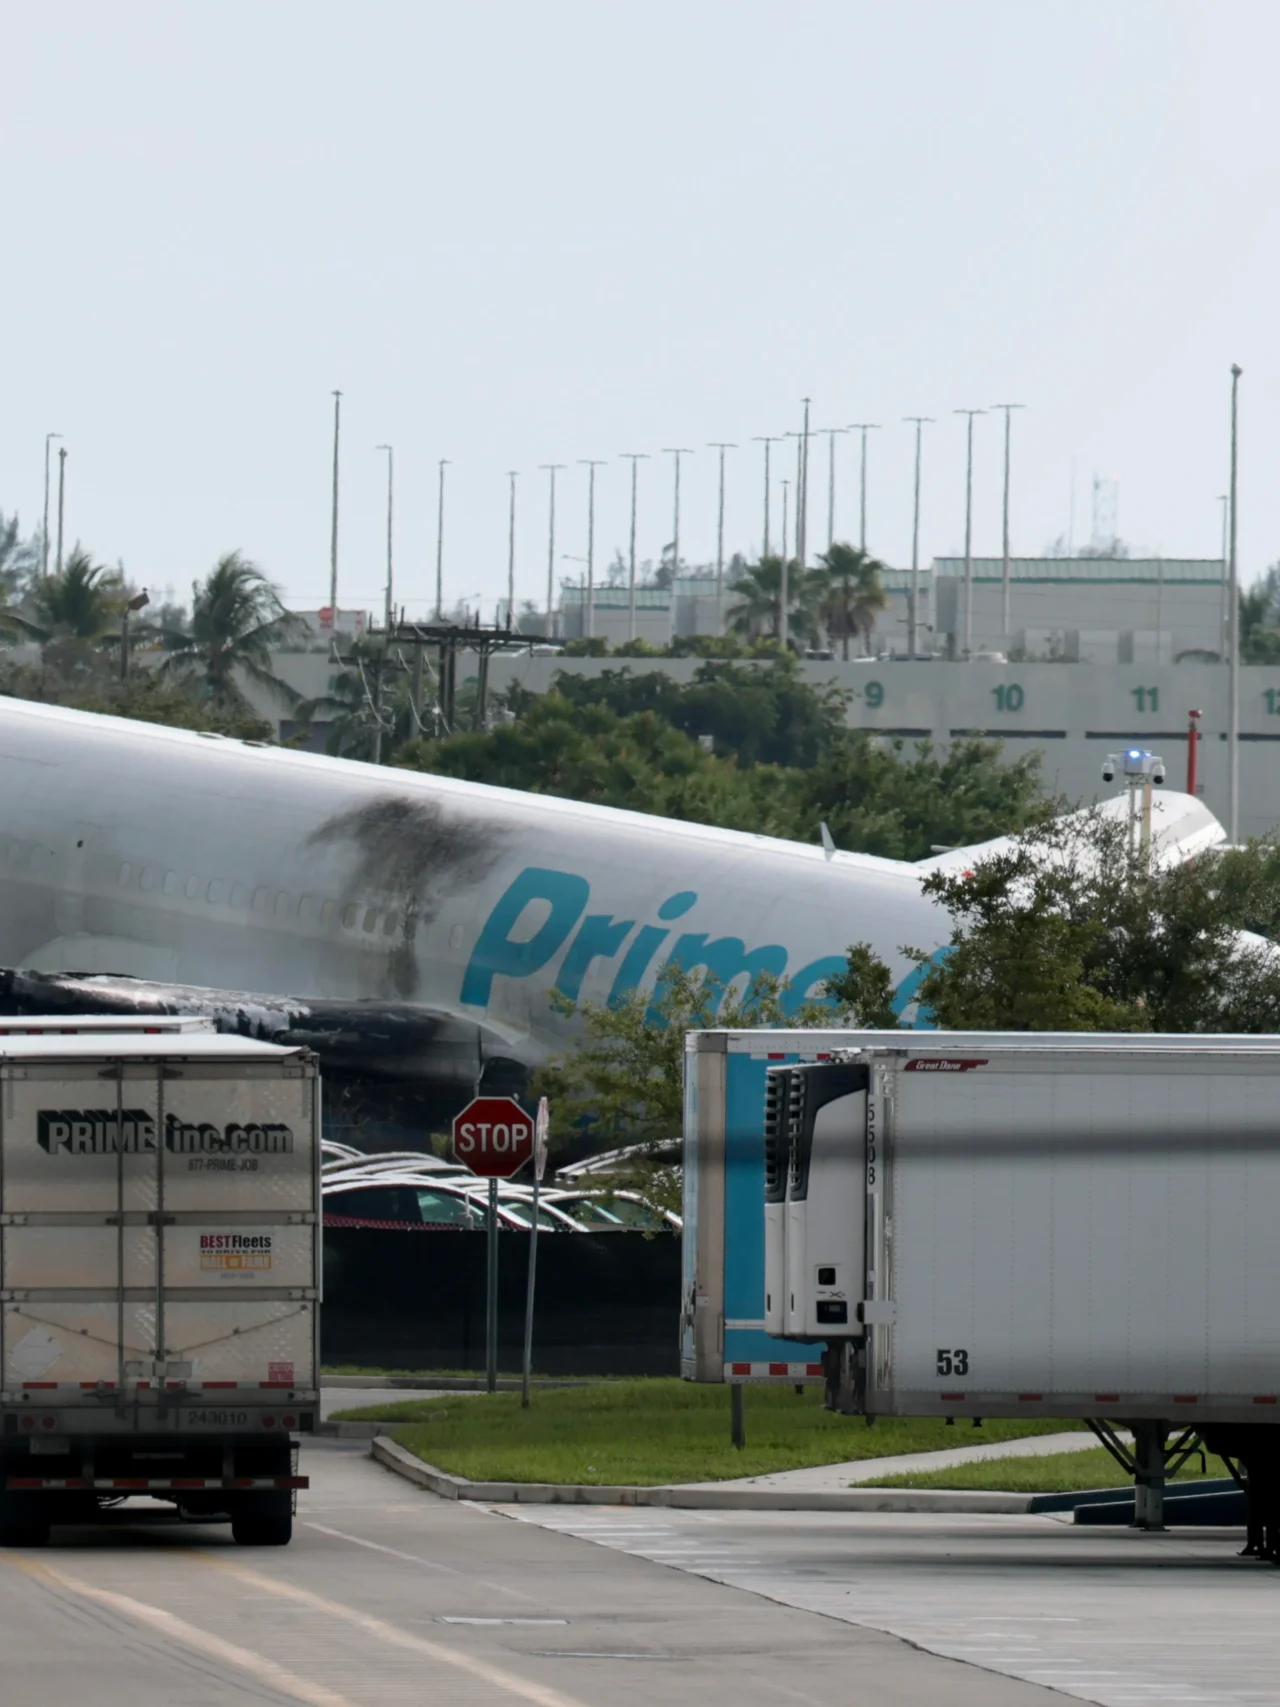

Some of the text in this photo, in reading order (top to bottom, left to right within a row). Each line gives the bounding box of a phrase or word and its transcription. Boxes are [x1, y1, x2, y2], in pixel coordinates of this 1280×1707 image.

[864, 681, 884, 709] 9
[991, 683, 1024, 712] 10
[1131, 686, 1158, 712] 11
[916, 1060, 961, 1070] Great Dane
[37, 1109, 294, 1154] PRIME inc.com
[459, 1122, 528, 1152] STOP
[188, 1158, 259, 1172] 877-PRIME-JOB
[937, 1349, 969, 1376] 53
